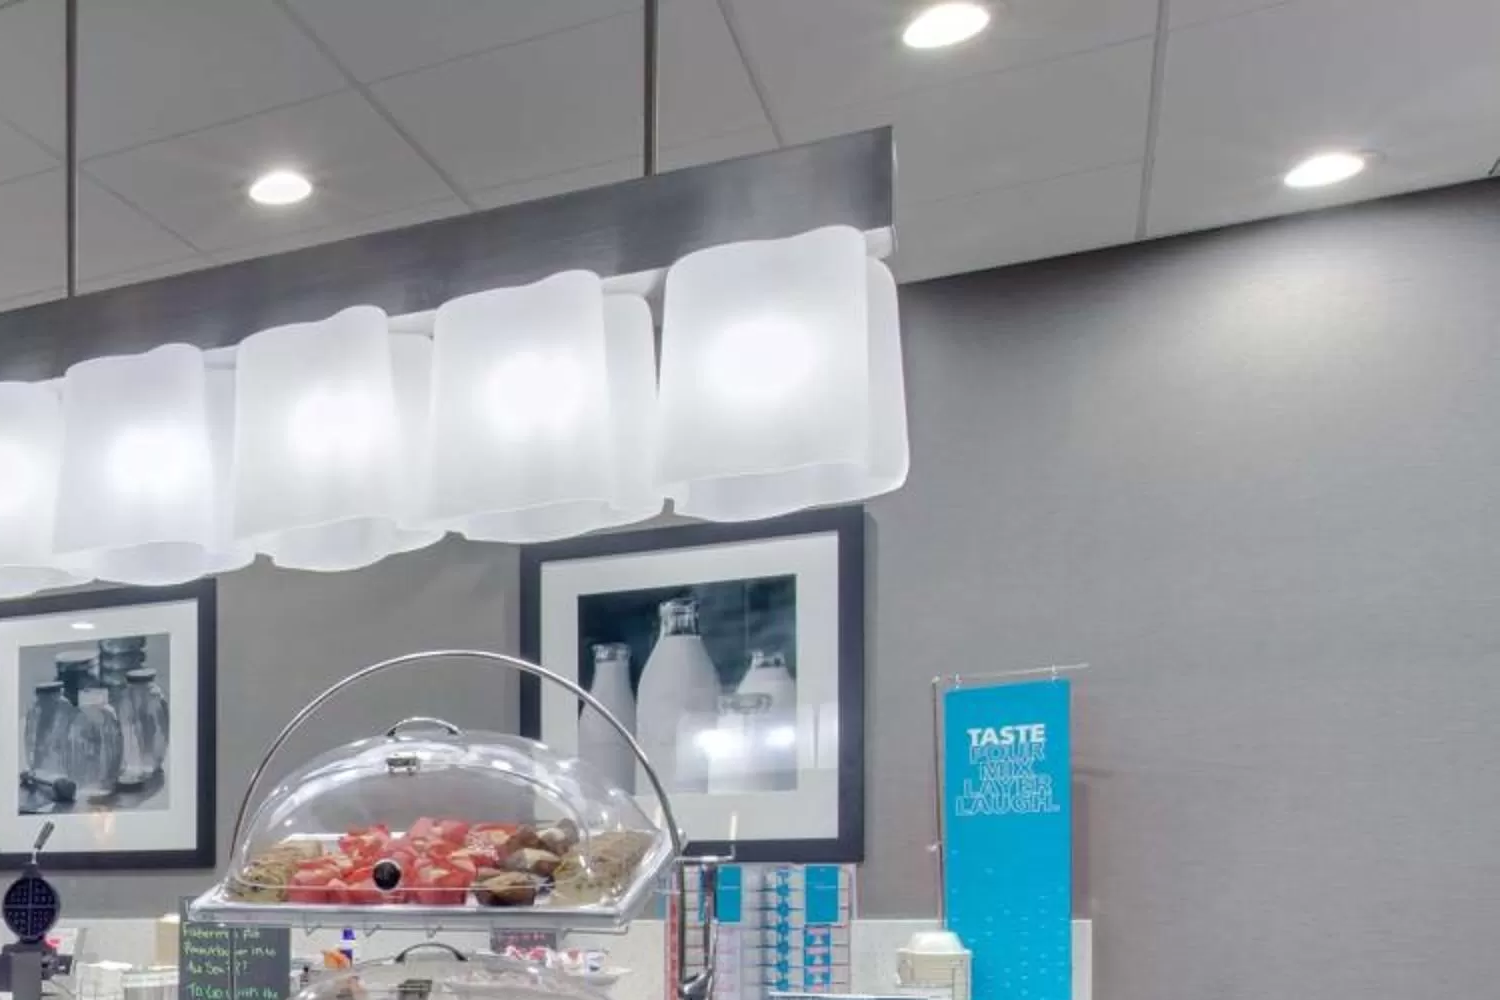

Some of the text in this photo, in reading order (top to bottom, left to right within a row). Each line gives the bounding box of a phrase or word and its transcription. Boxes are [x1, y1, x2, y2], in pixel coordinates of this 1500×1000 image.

[966, 723, 1045, 746] TASTE
[969, 742, 1045, 764] POUR
[980, 758, 1033, 780] MIX
[963, 774, 1052, 799] LAYER
[955, 794, 1060, 816] LAUGH.
